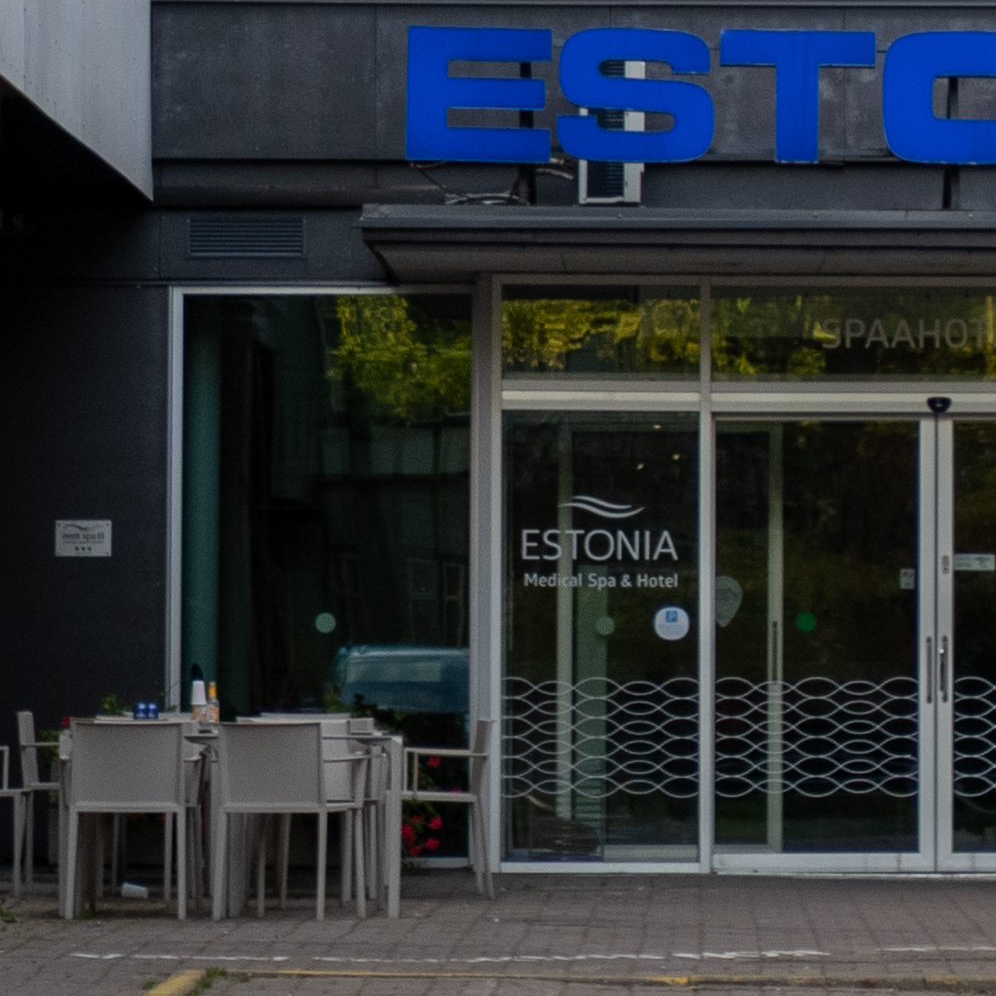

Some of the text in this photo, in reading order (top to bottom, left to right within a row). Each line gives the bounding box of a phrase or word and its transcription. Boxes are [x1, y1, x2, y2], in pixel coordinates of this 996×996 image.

[520, 529, 679, 561] ESTONIA
[523, 572, 679, 591] Medical Spa & Hotel
